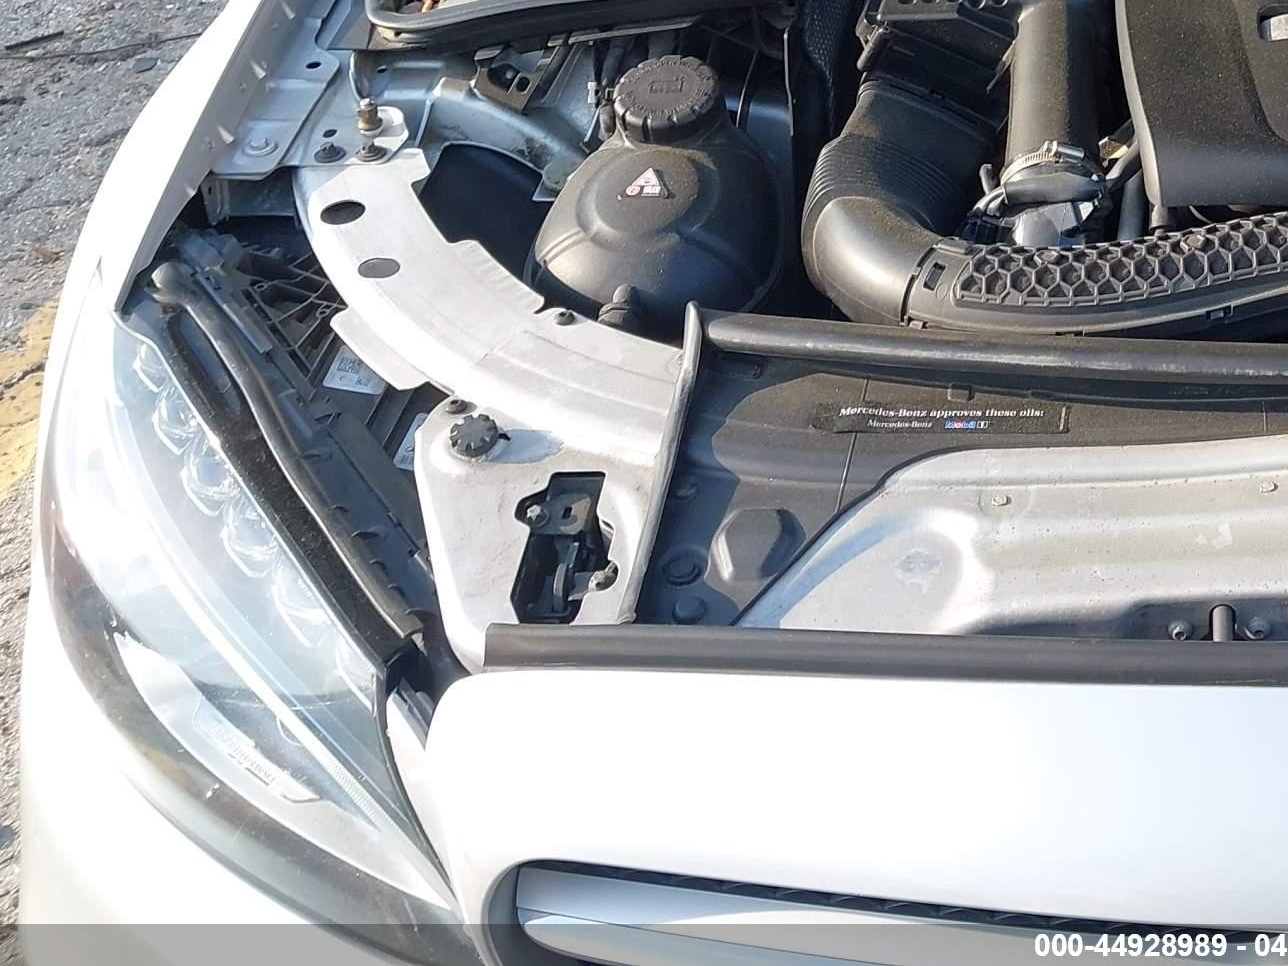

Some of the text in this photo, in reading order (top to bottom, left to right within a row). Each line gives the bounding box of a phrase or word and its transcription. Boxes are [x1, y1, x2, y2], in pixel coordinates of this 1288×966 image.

[839, 406, 1044, 419] Mercedes-Benz approves these oils:
[867, 419, 933, 428] Mercedes-Benz
